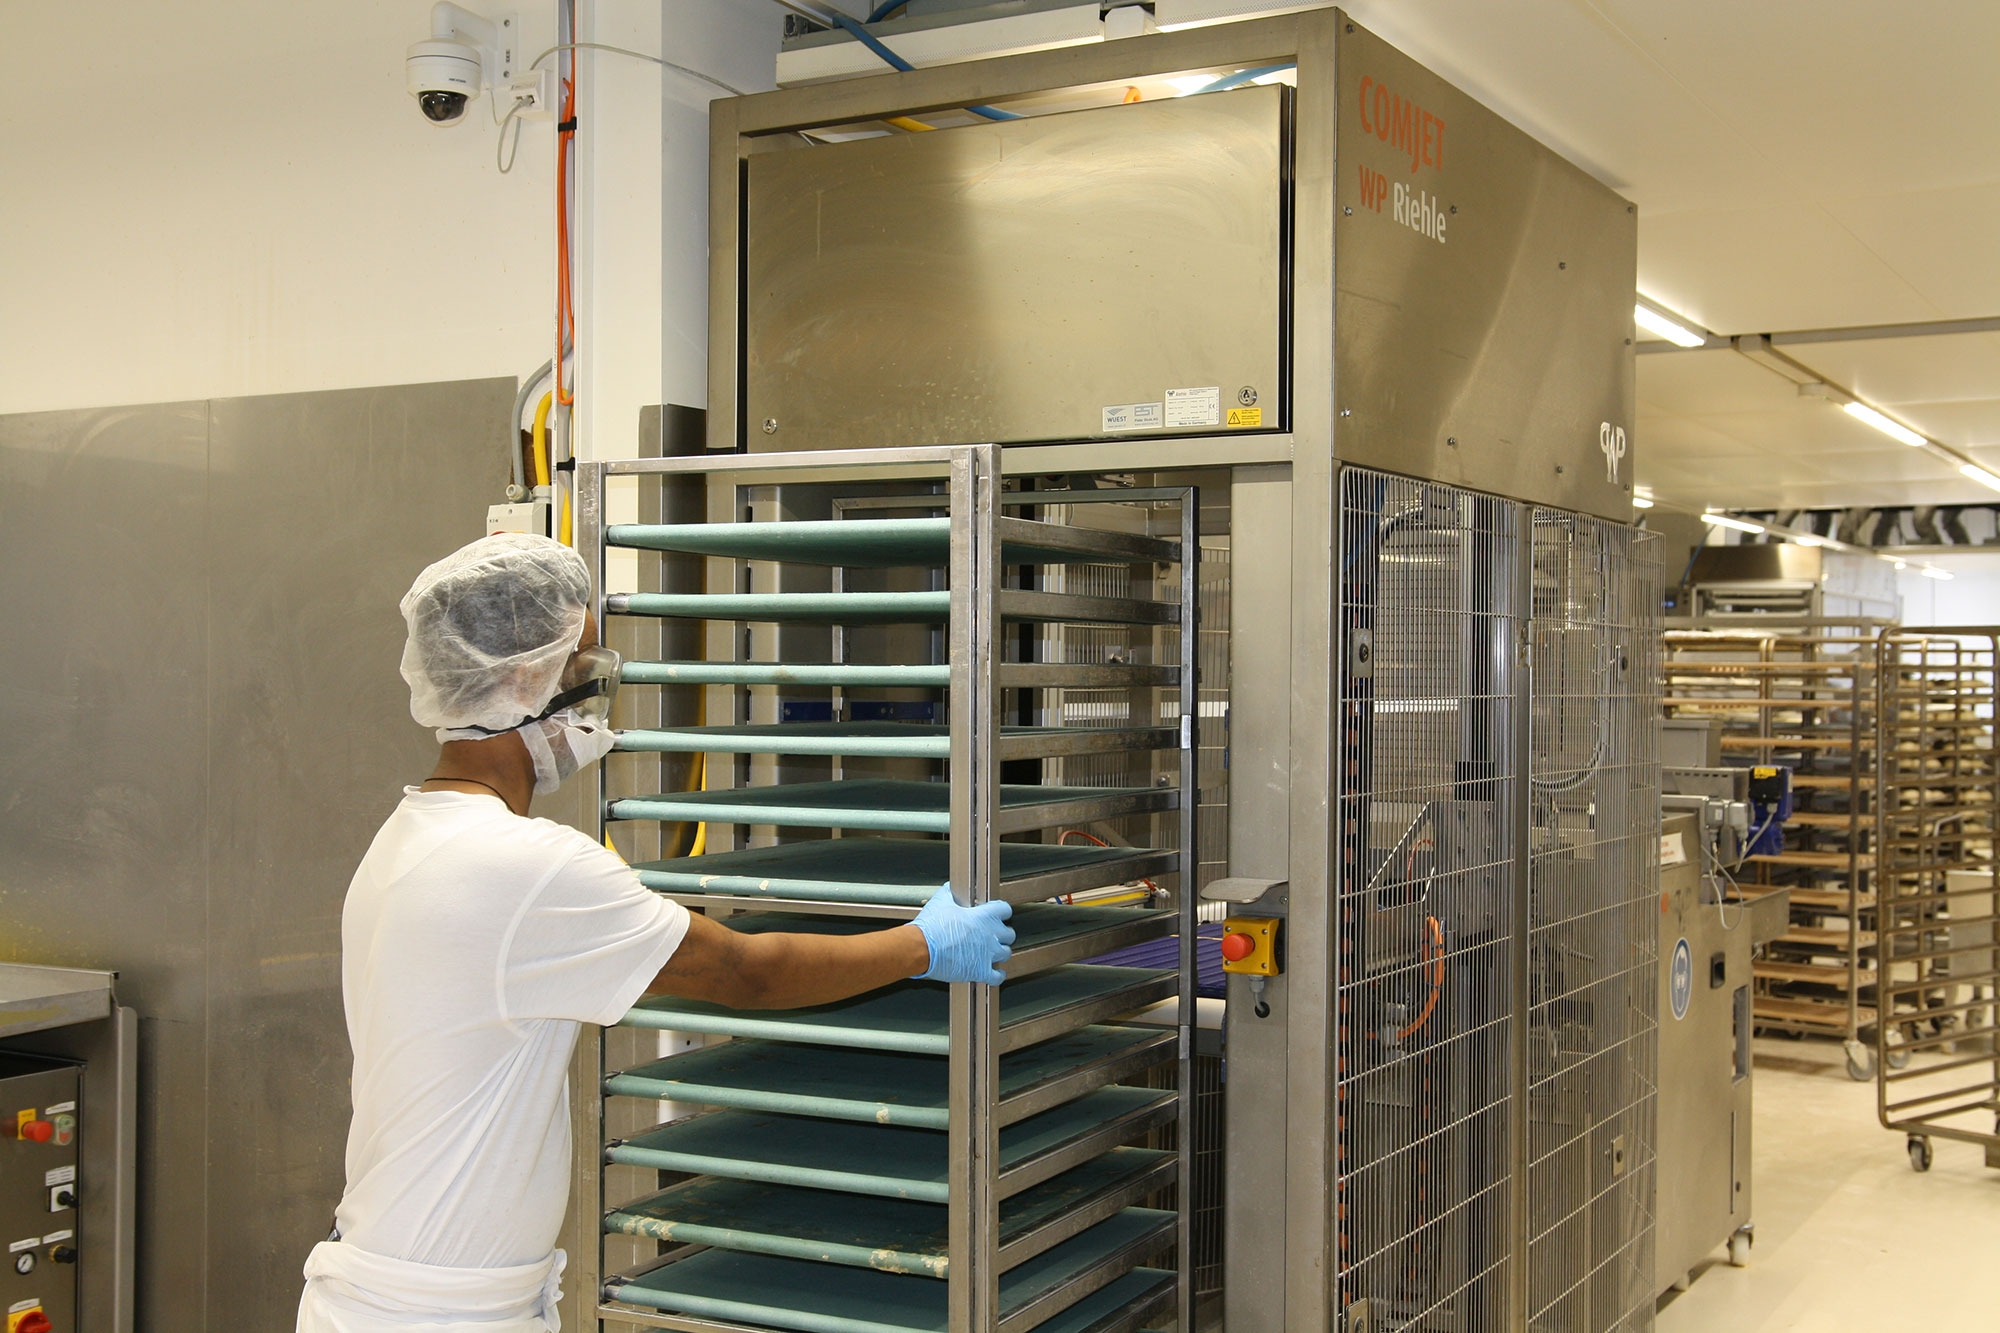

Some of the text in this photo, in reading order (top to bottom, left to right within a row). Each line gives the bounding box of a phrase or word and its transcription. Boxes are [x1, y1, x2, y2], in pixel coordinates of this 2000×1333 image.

[1359, 75, 1447, 174] COMJET
[1359, 164, 1447, 243] WP Riehle
